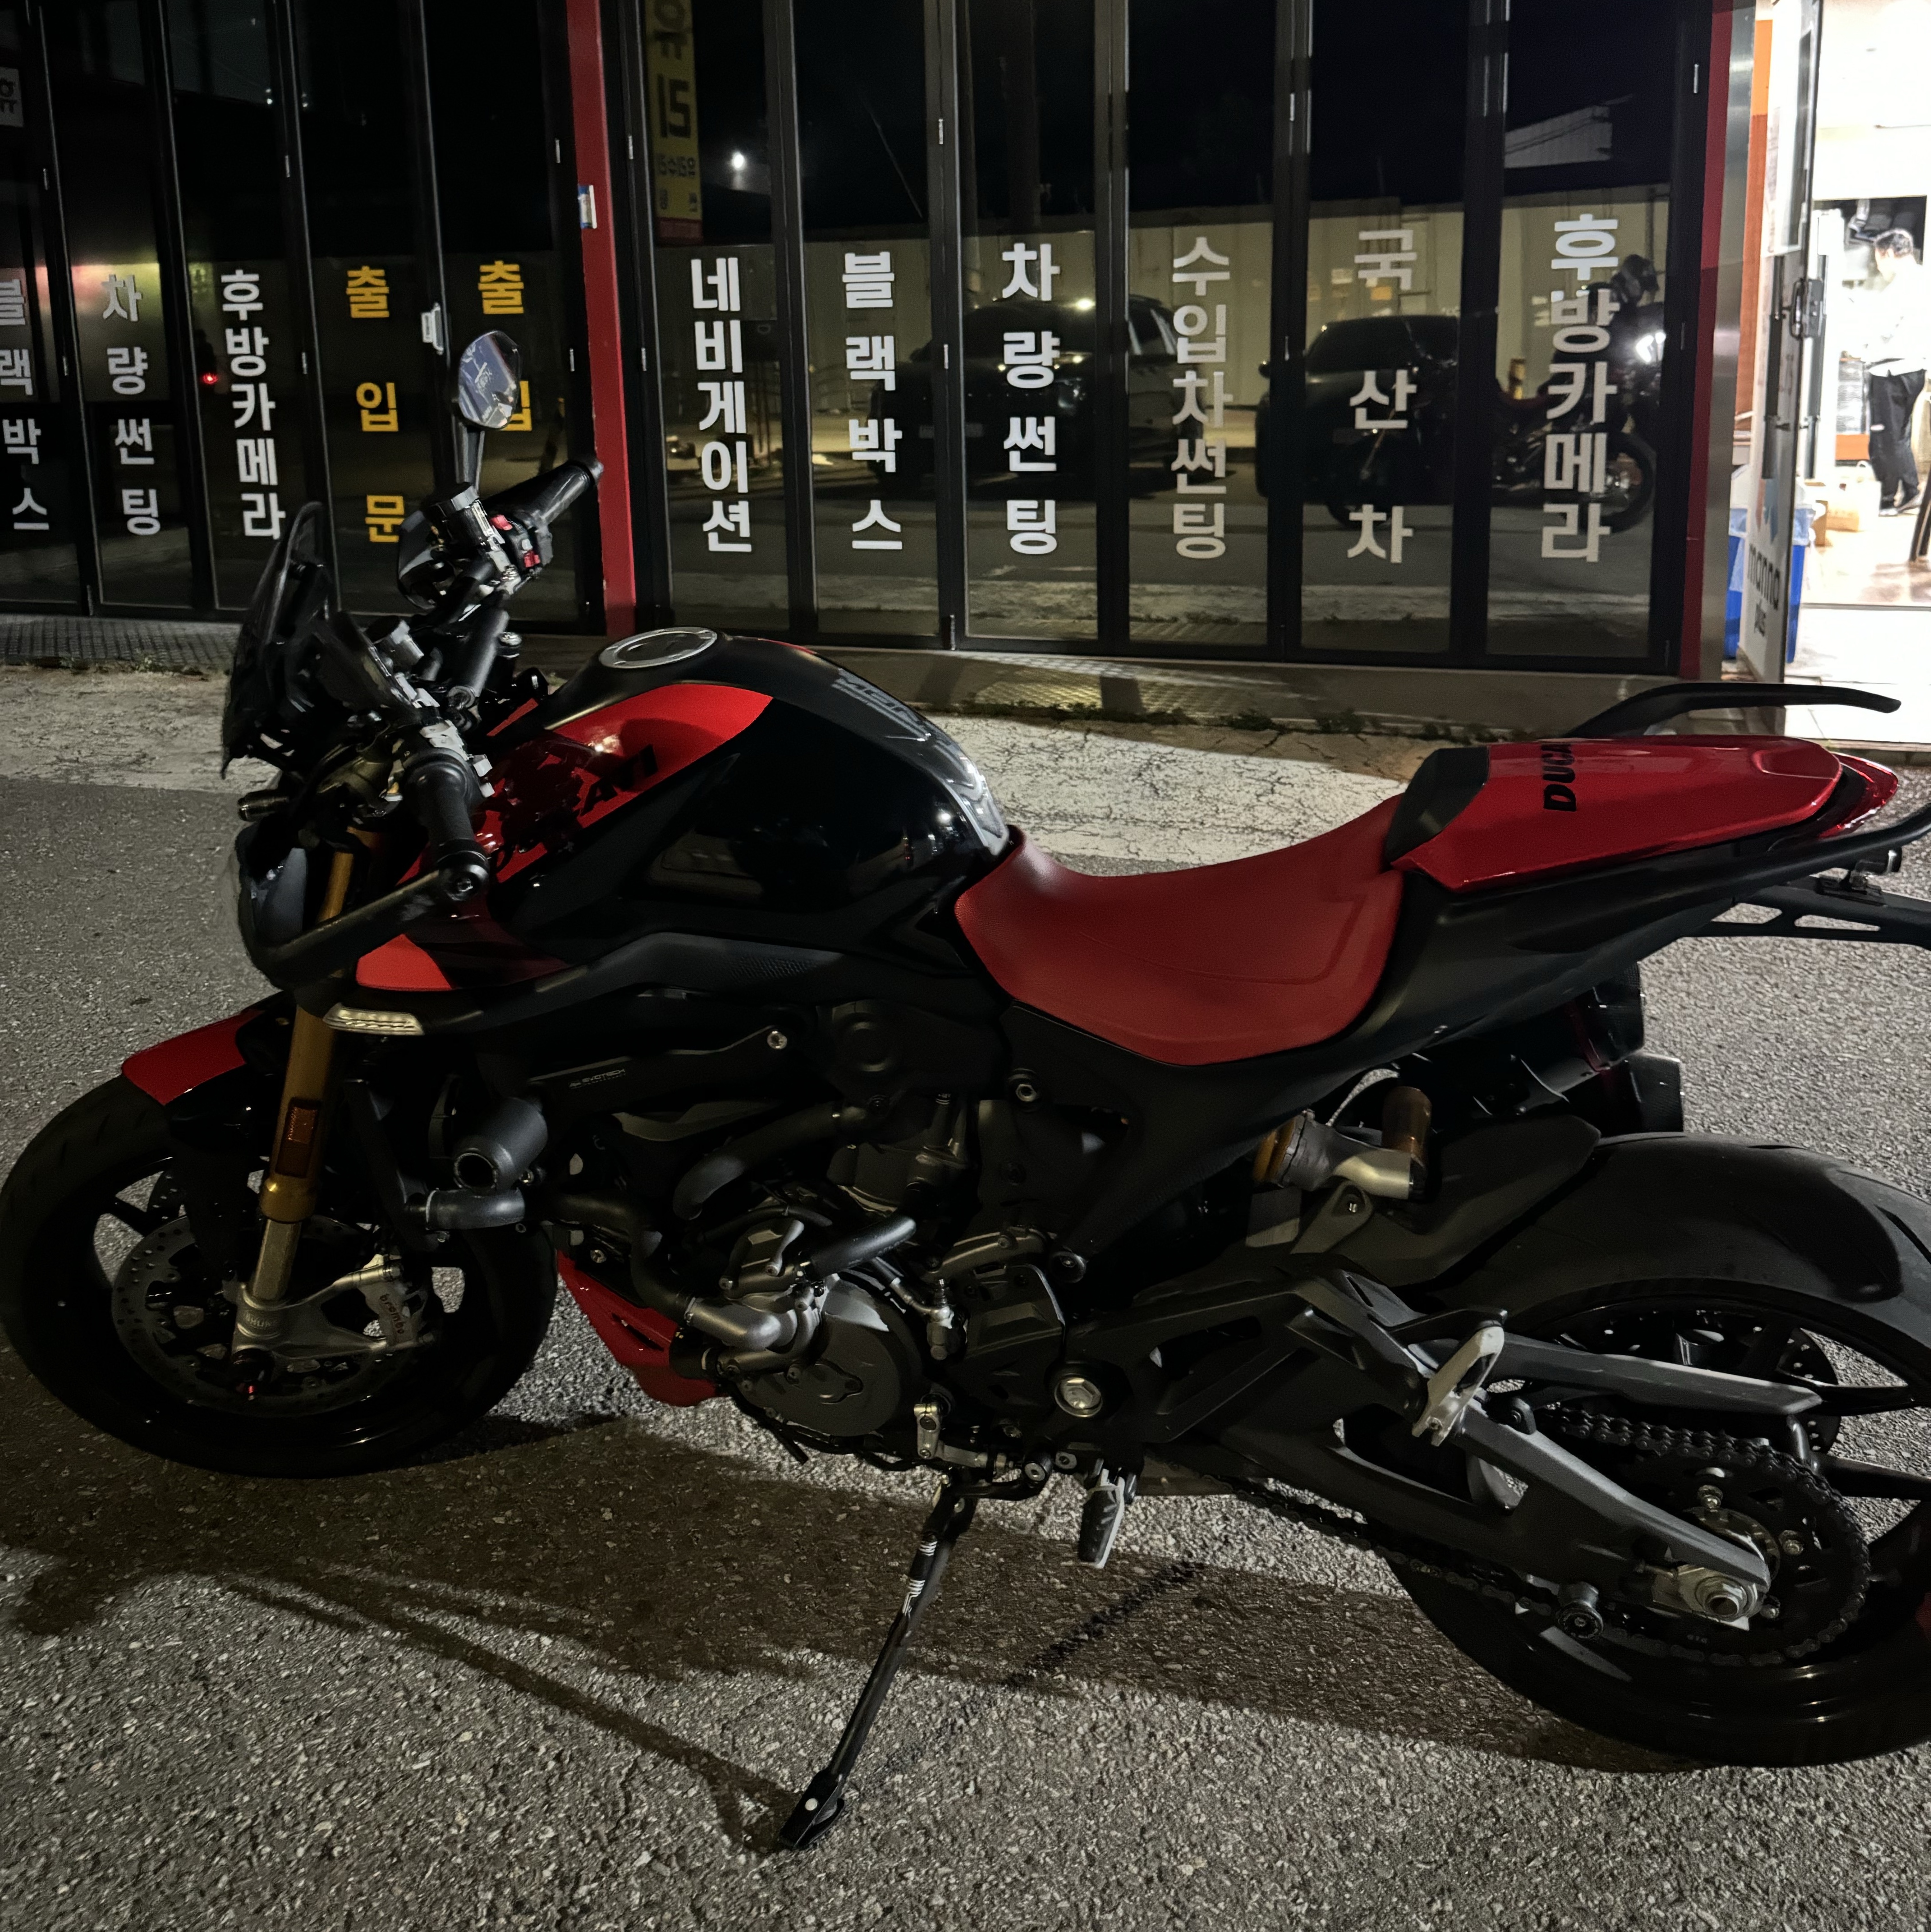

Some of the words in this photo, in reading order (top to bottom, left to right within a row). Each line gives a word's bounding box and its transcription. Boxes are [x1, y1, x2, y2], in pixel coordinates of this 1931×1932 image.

[0, 279, 49, 530] 블랙박스
[102, 274, 161, 535] 차량썬팅
[221, 270, 285, 539] 후방카메라
[346, 266, 404, 542] 출입문
[691, 257, 752, 552] 네비게이션
[842, 251, 903, 550] 블랙박스
[1002, 243, 1060, 555] 차량썬팅
[1171, 237, 1233, 559] 수입차썬팅
[1347, 229, 1417, 563] 국산차
[1541, 213, 1620, 562] 후방카메라
